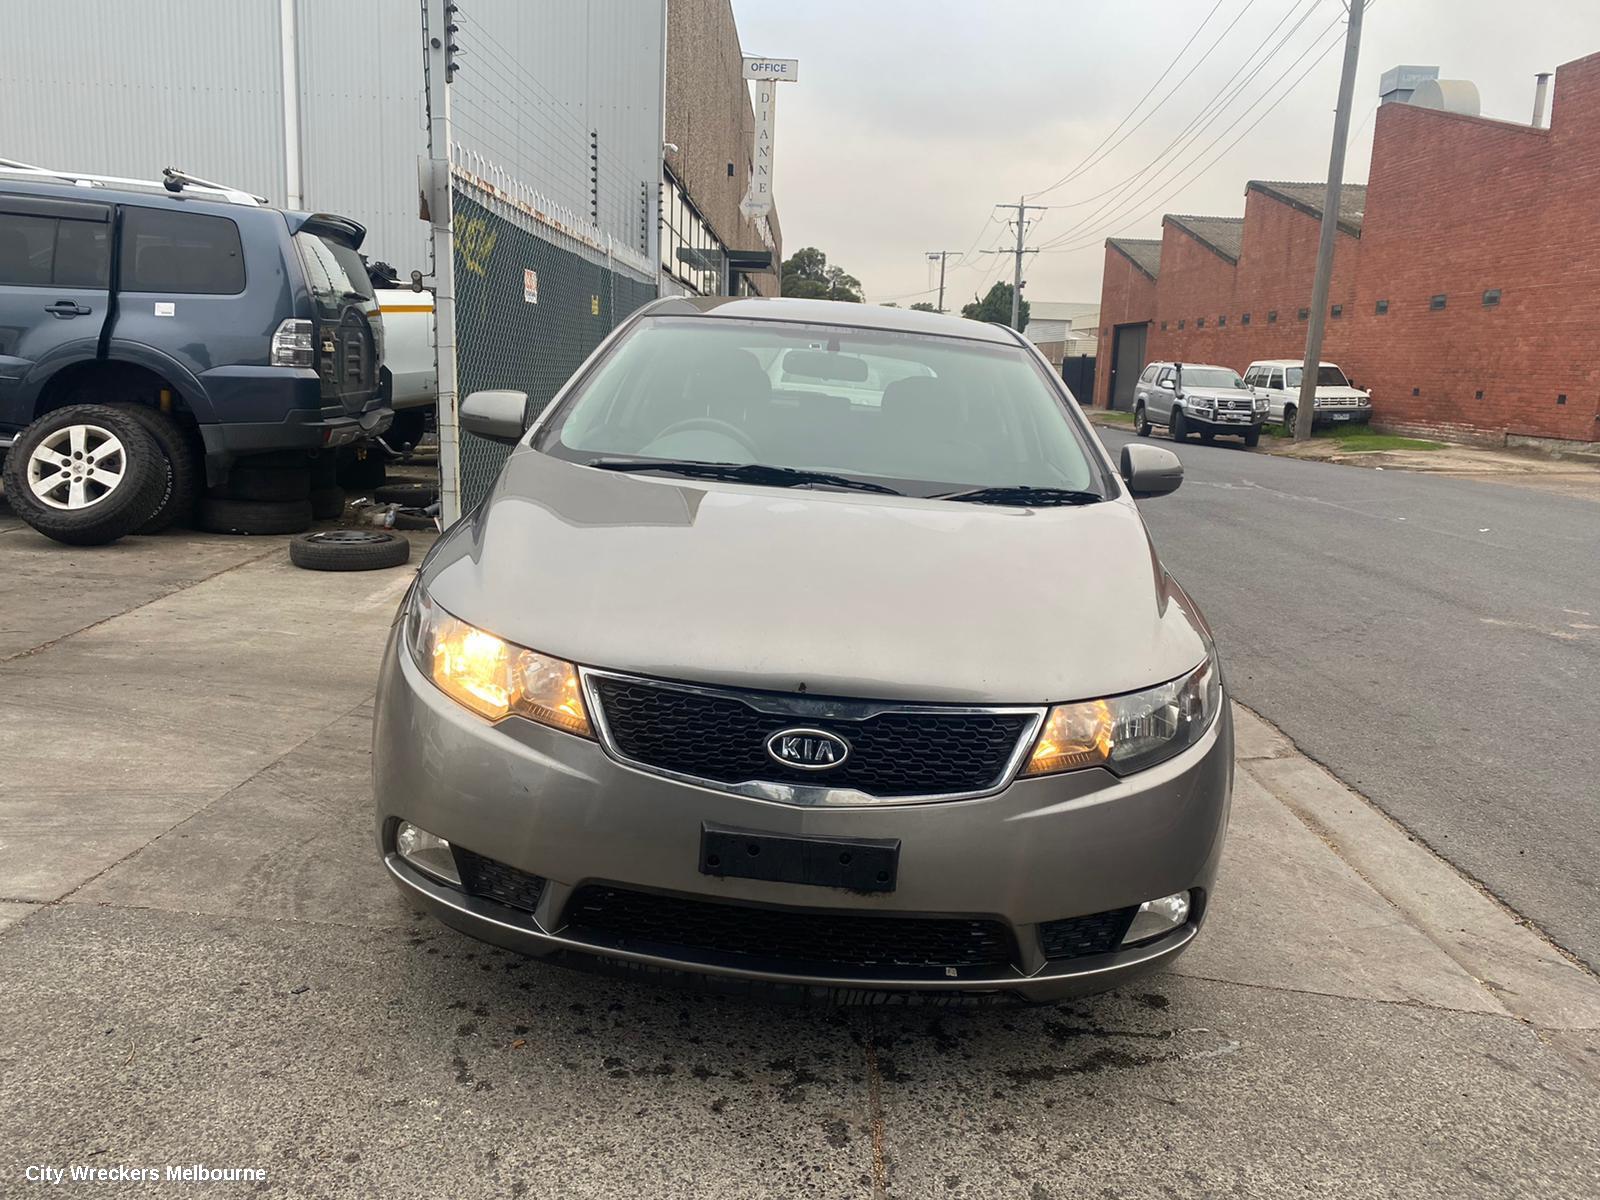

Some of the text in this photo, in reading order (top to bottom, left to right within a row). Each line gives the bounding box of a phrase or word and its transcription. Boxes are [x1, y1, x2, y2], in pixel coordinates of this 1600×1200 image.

[751, 63, 787, 73] OFFICE
[759, 92, 770, 193] DIANNE
[782, 737, 835, 762] KIA
